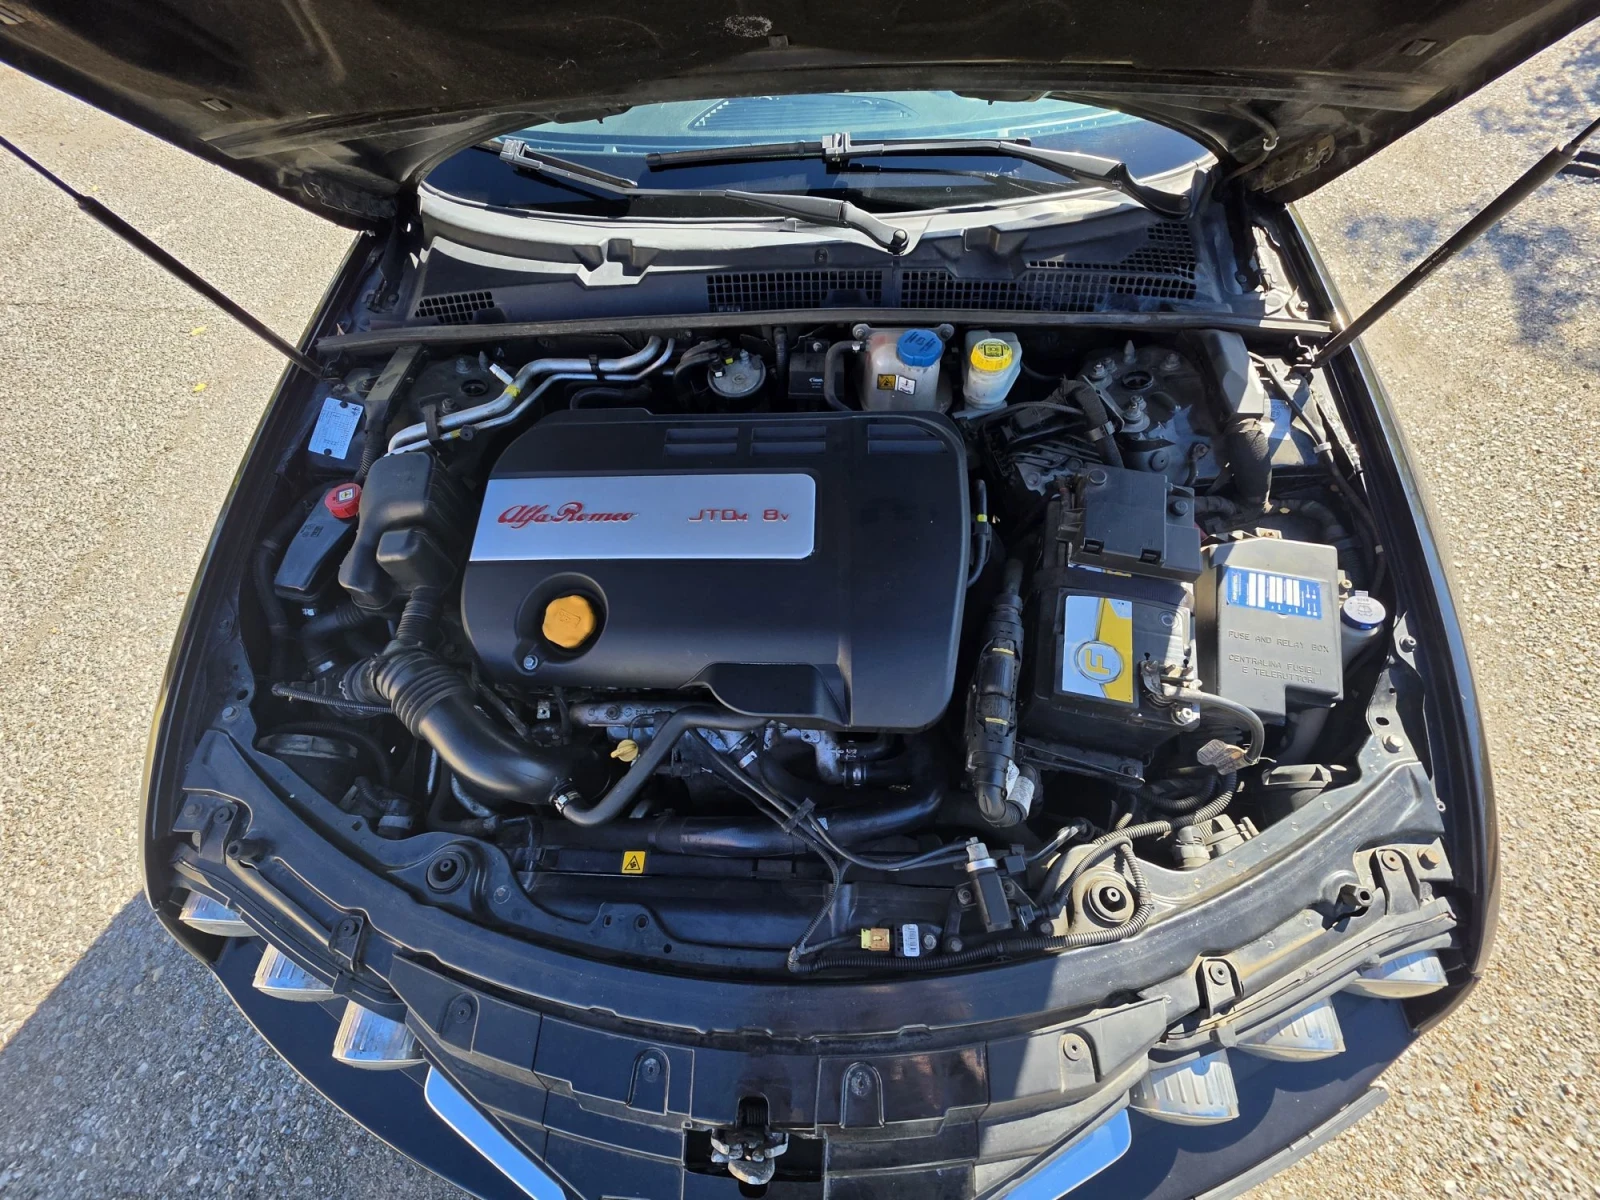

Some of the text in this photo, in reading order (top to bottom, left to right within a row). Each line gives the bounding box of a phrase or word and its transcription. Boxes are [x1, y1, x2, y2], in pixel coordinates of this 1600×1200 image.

[497, 501, 639, 530] Alfa Romeo
[1228, 630, 1329, 653] FUSE AND RELAY BOX
[1084, 649, 1111, 675] F
[1228, 653, 1322, 676] CENTRALINA FUSIBILI
[1241, 666, 1249, 674] E
